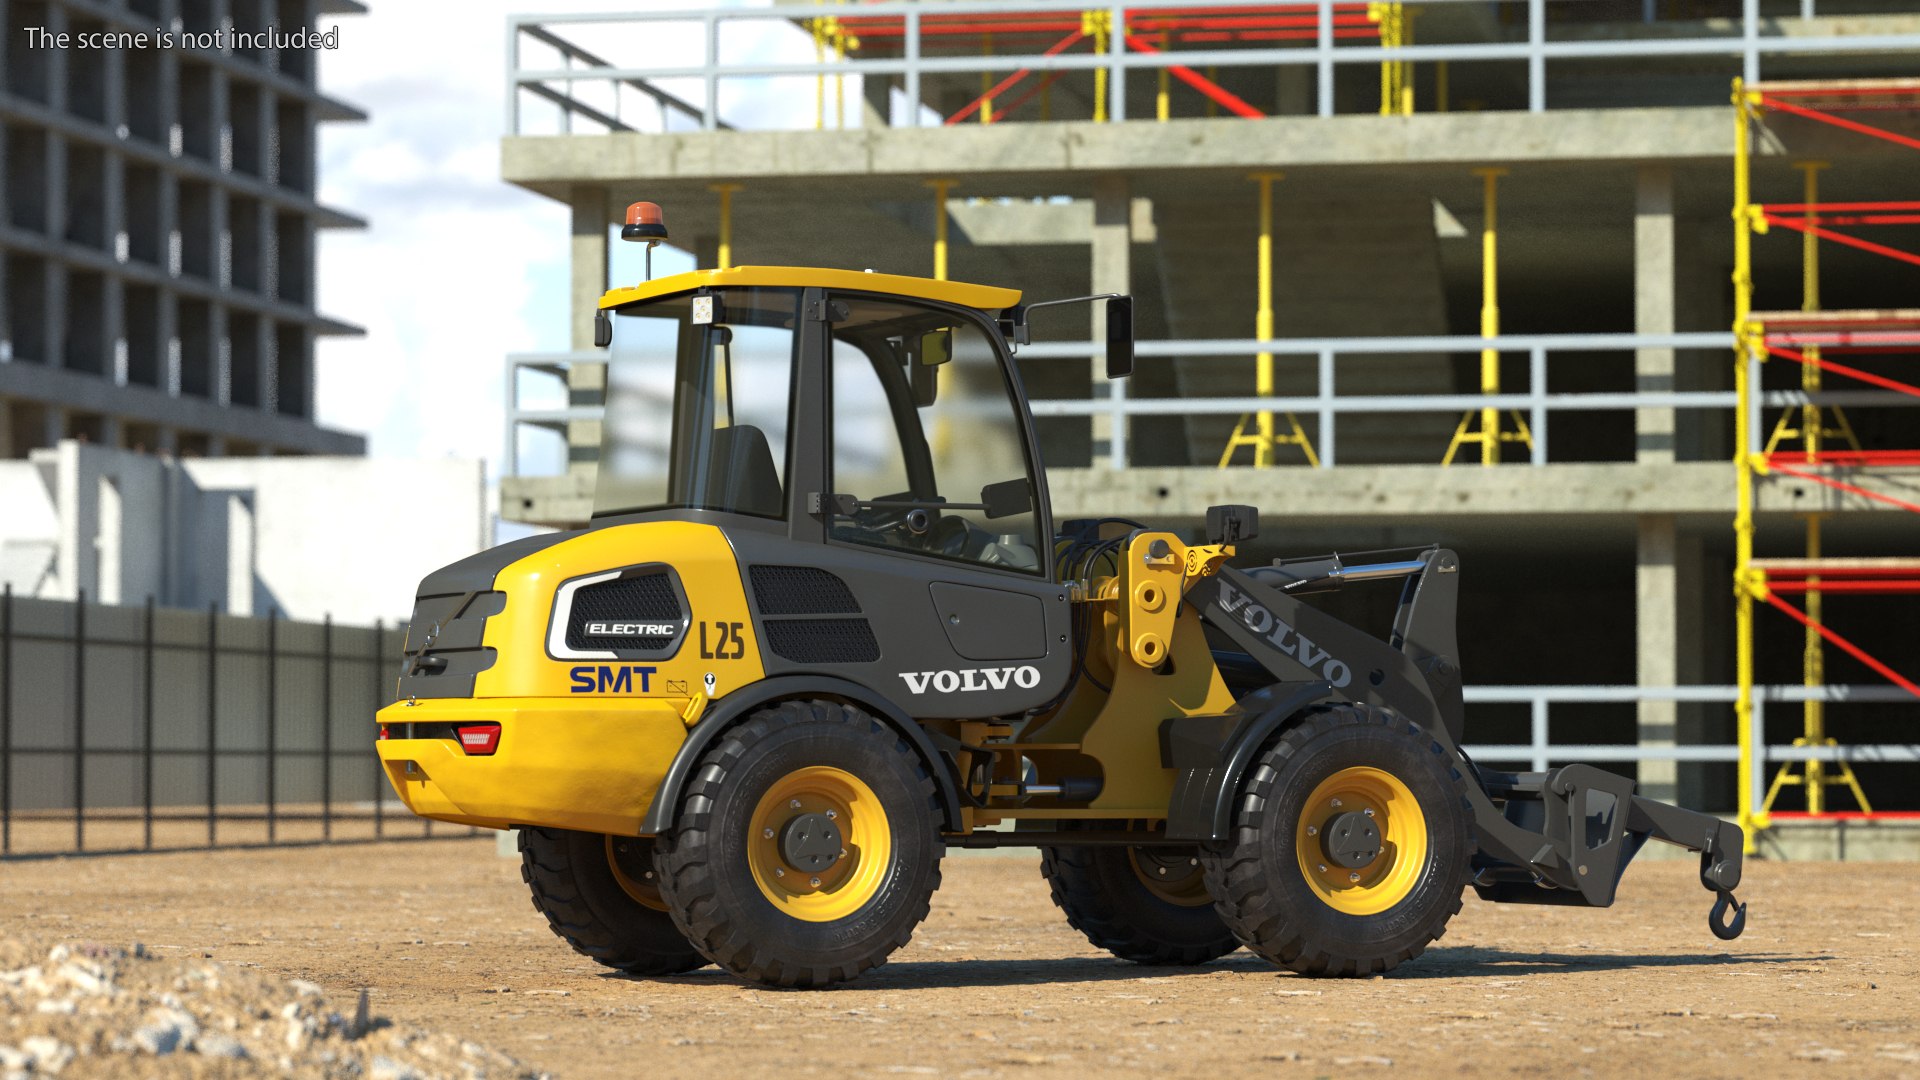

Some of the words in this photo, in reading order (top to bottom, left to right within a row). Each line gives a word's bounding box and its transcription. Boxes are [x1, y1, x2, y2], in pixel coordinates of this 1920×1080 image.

[590, 623, 674, 635] ELECTRIC
[700, 622, 744, 660] L25
[1217, 578, 1352, 688] VOLVO
[570, 666, 657, 693] SMT
[899, 665, 1041, 694] VOLVO
